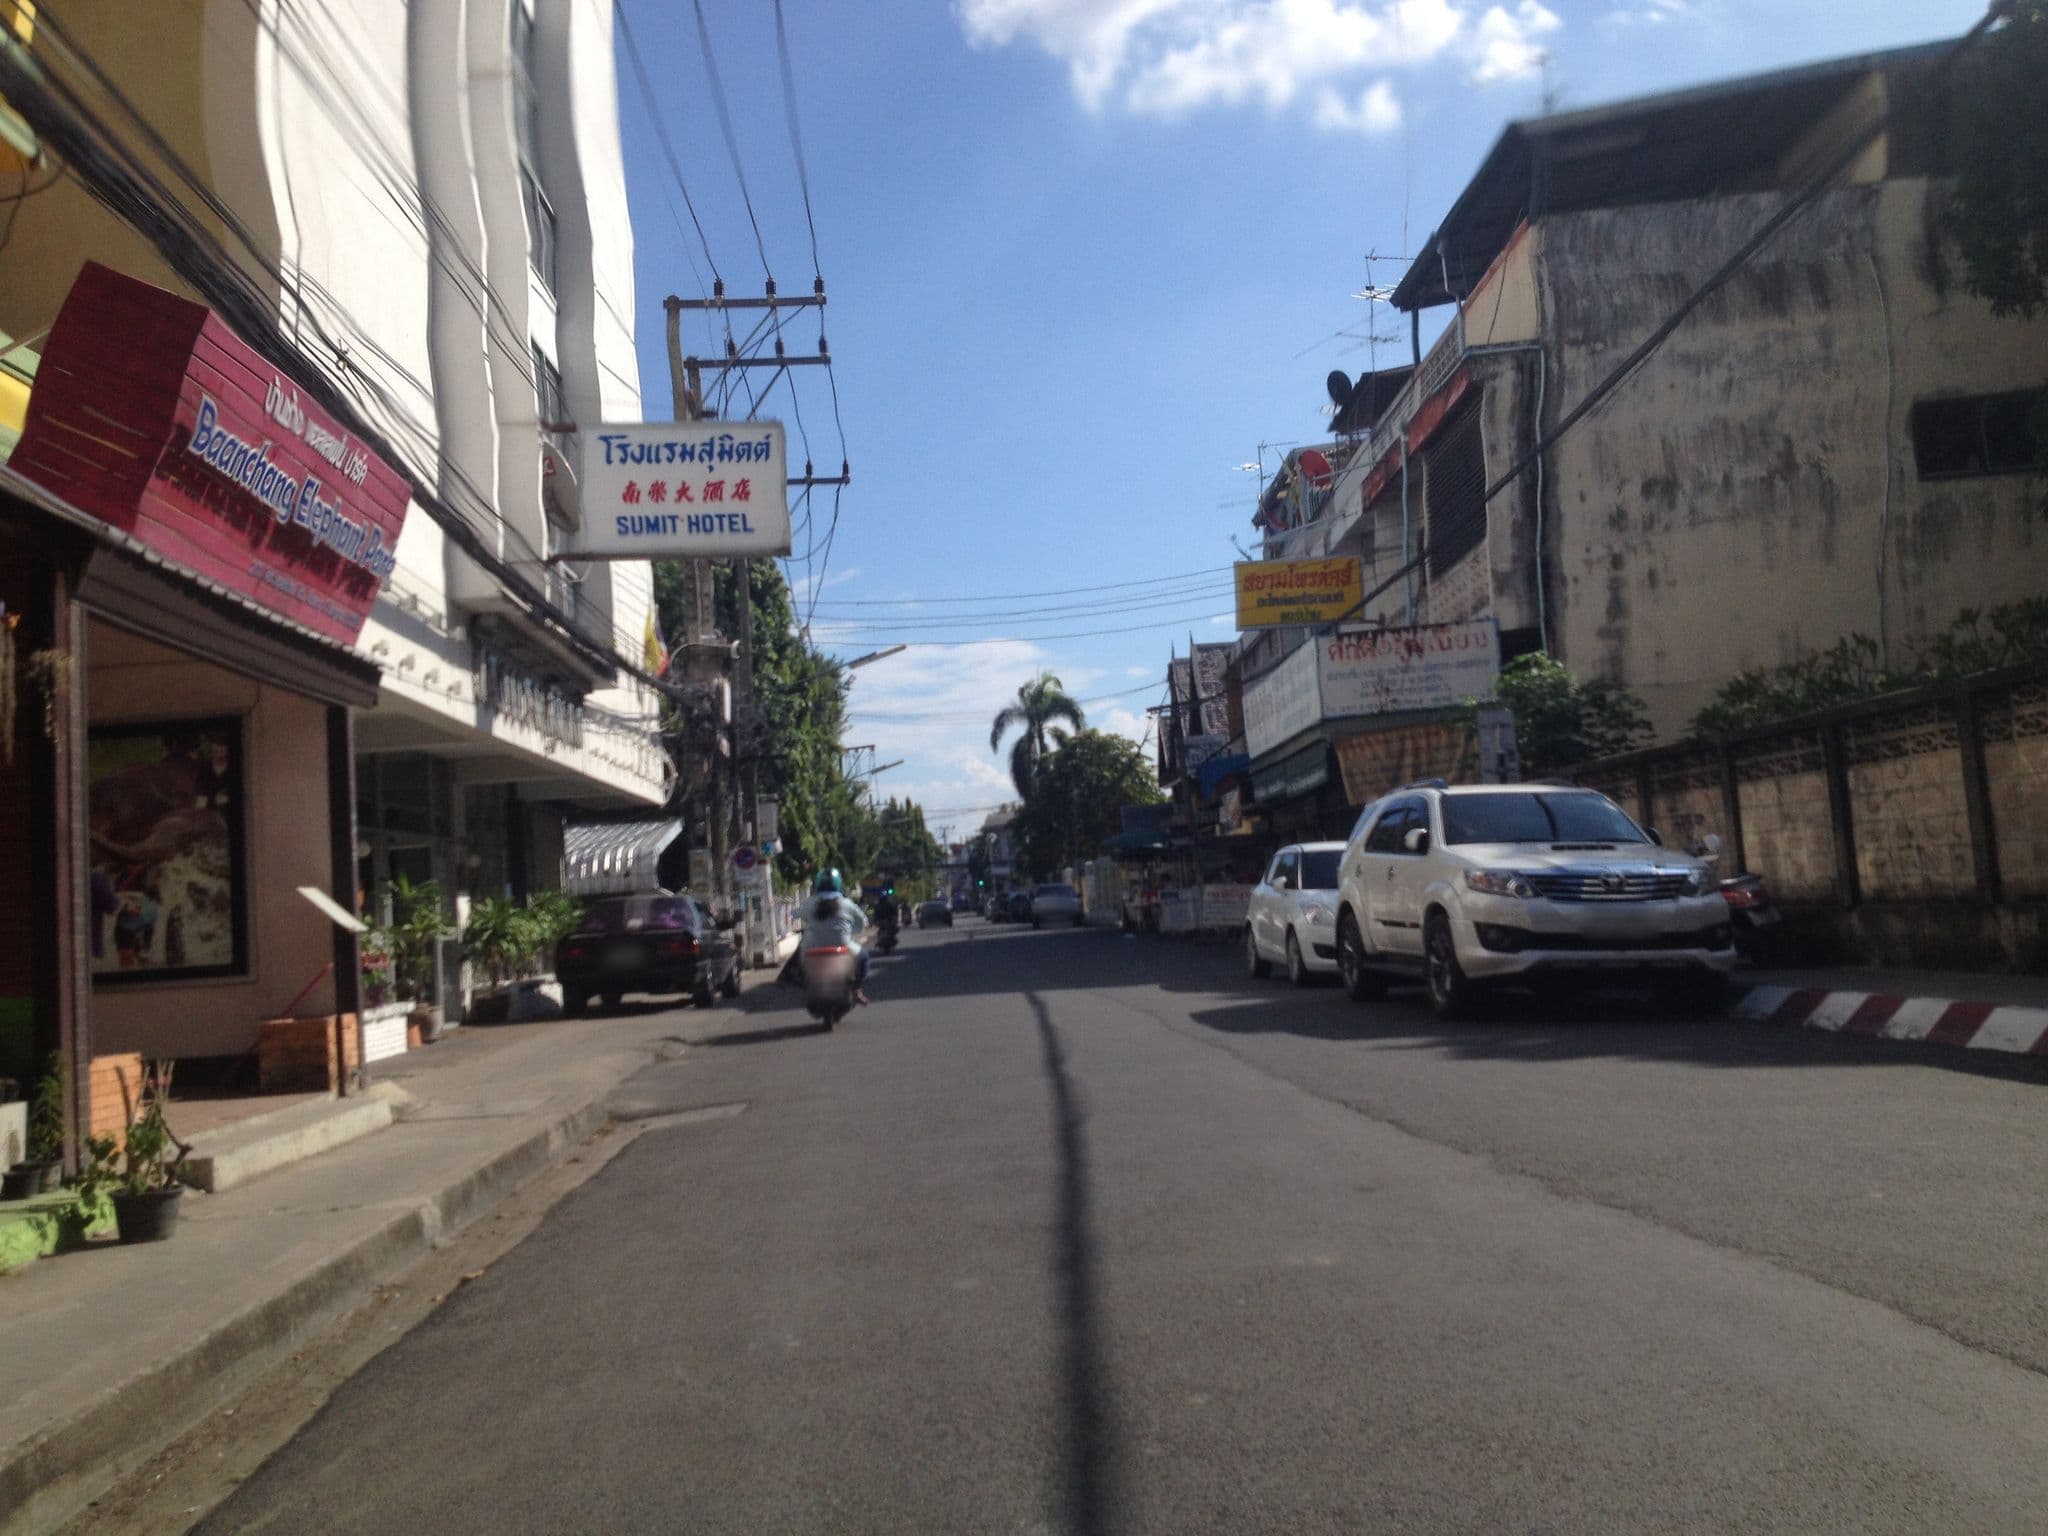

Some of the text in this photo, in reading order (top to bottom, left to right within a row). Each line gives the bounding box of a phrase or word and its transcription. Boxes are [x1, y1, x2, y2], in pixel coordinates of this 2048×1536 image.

[598, 433, 772, 473] โรงแรมสุมิตต์
[188, 393, 298, 524] Baanchang
[294, 473, 368, 563] Elephant
[616, 513, 755, 537] SUMIT HOTEL
